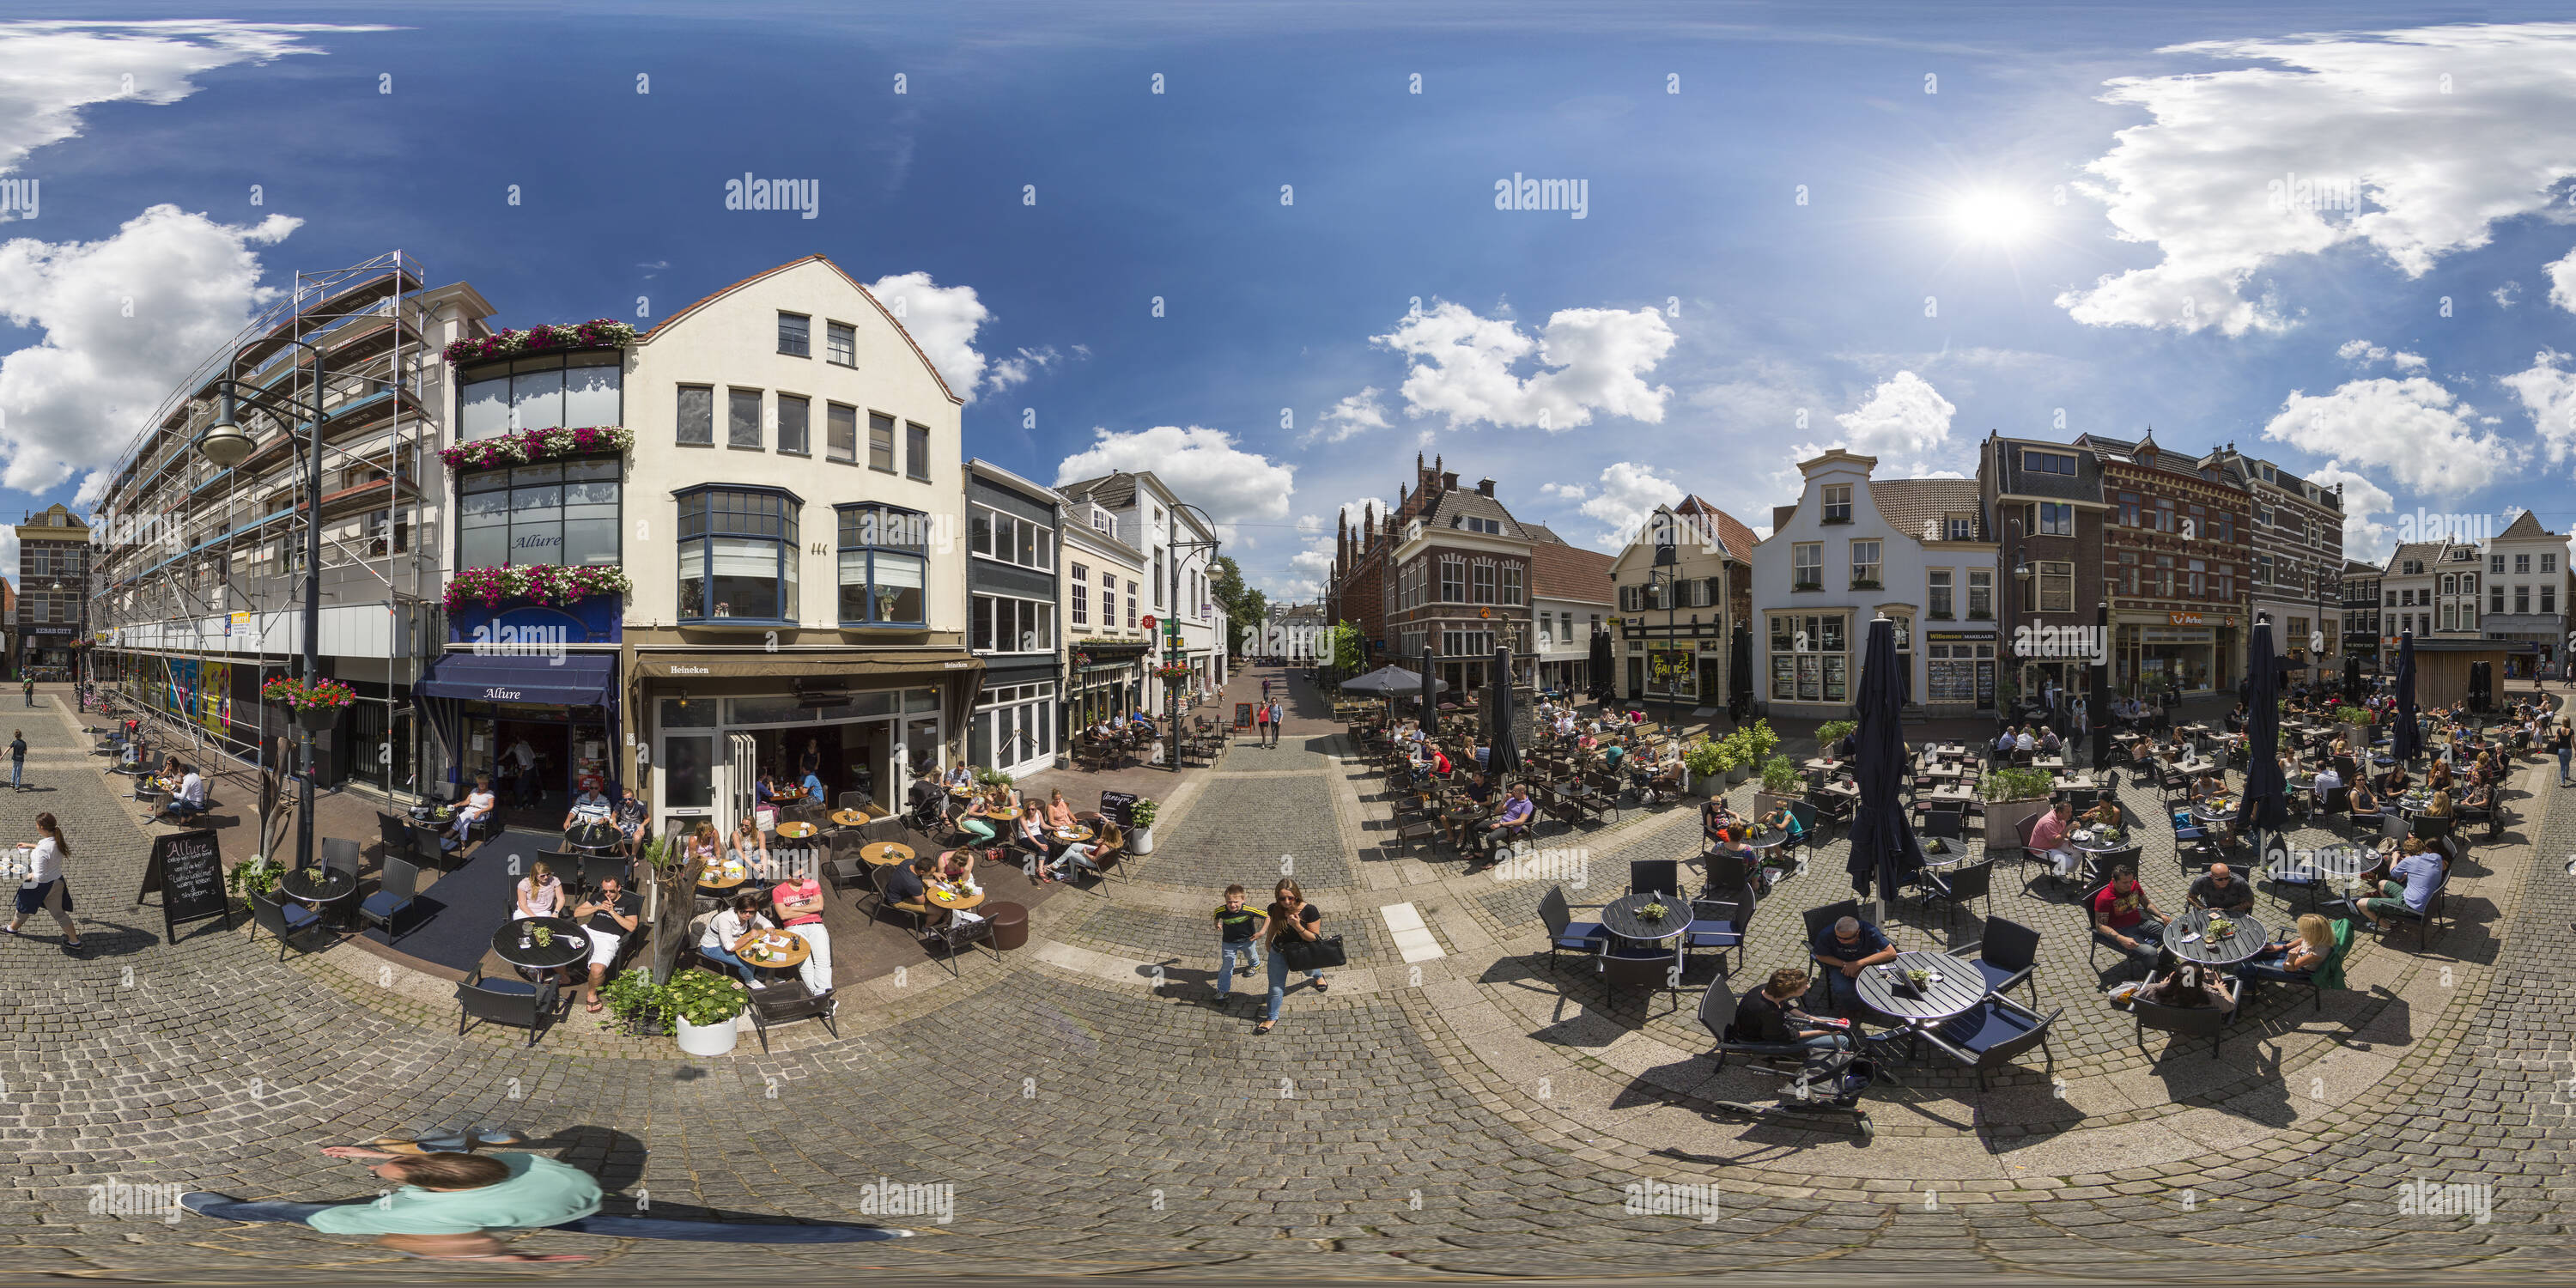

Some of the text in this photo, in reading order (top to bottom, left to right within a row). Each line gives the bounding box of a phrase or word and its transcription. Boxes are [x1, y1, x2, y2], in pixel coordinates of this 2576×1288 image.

[512, 533, 562, 550] Allure
[2185, 616, 2202, 624] Arke
[671, 665, 709, 674] Heineken
[945, 660, 968, 669] Heineken
[483, 687, 521, 700] Allure
[166, 840, 208, 858] Allure
